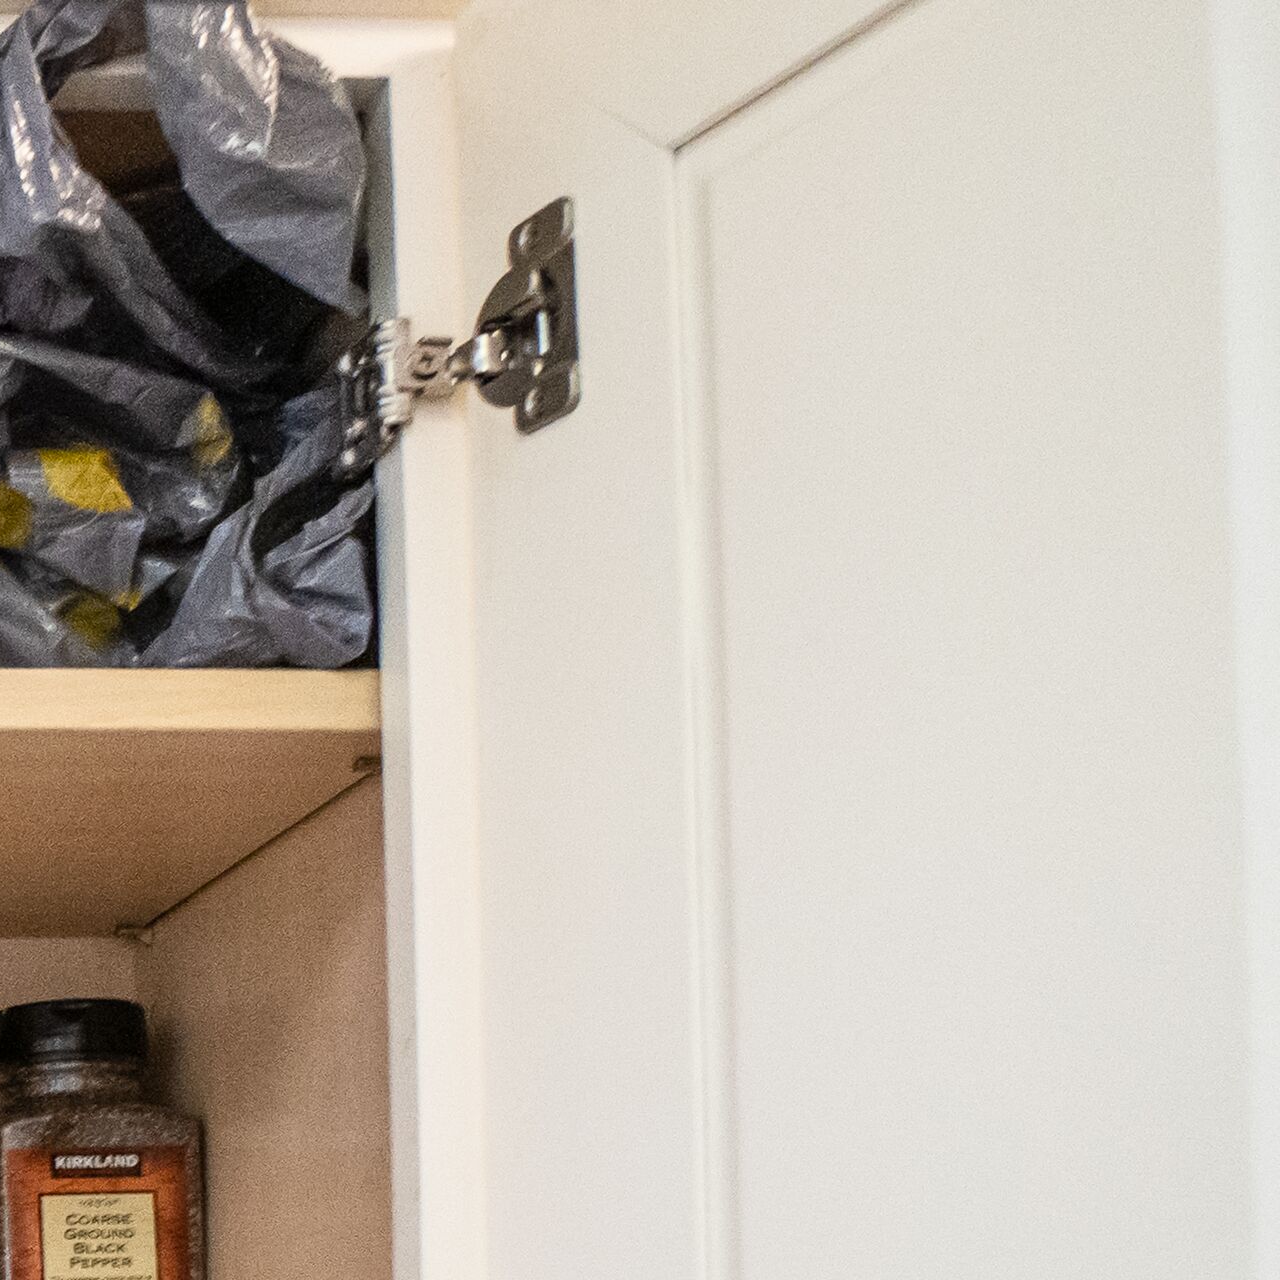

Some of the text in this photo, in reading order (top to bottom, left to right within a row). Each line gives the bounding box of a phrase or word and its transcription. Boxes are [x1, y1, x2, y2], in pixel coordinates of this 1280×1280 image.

[54, 1154, 139, 1169] KIRKLAND
[65, 1213, 134, 1226] COARSE
[63, 1227, 136, 1240] GROUND
[73, 1242, 128, 1255] BLACK
[69, 1256, 133, 1269] PEPPER
